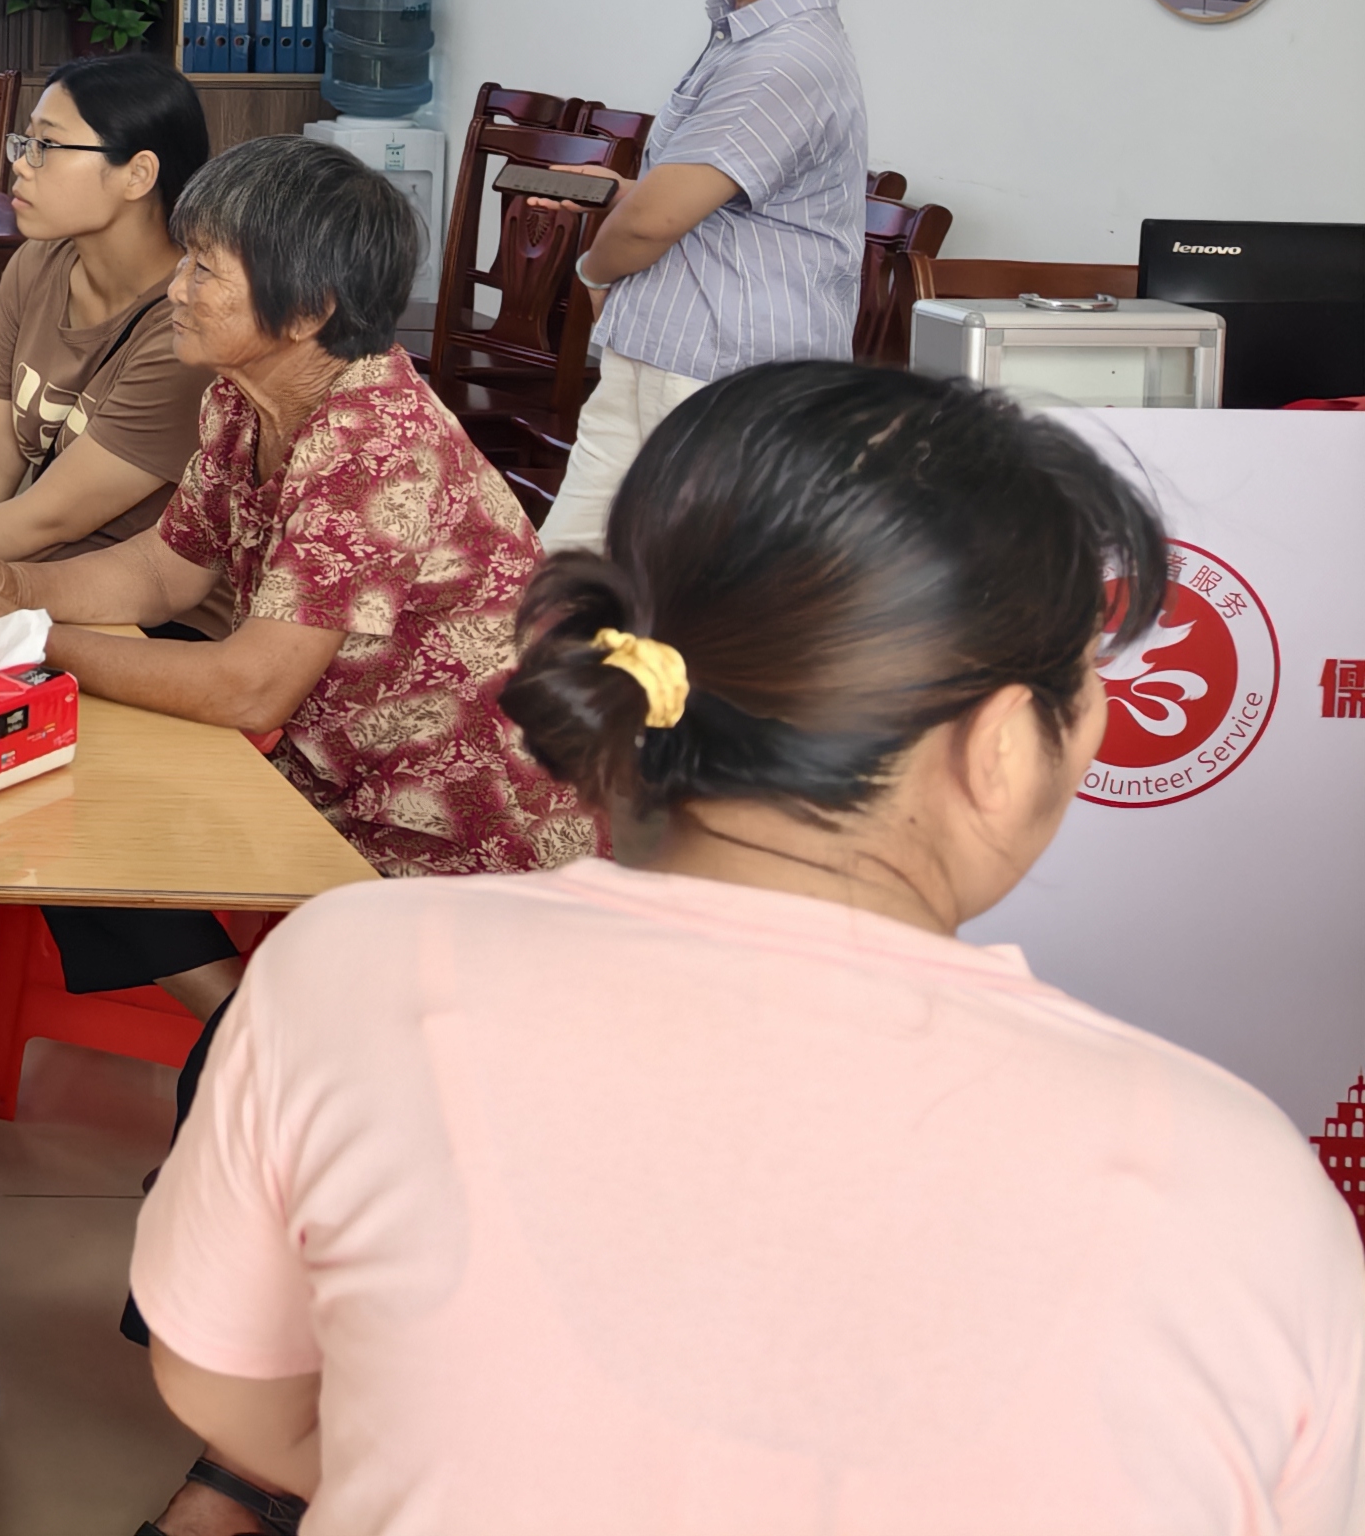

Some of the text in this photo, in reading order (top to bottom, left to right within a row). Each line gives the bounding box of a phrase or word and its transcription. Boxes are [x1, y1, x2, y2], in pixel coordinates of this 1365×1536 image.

[1172, 241, 1242, 255] lenovo
[1082, 691, 1263, 796] olunteer Service
